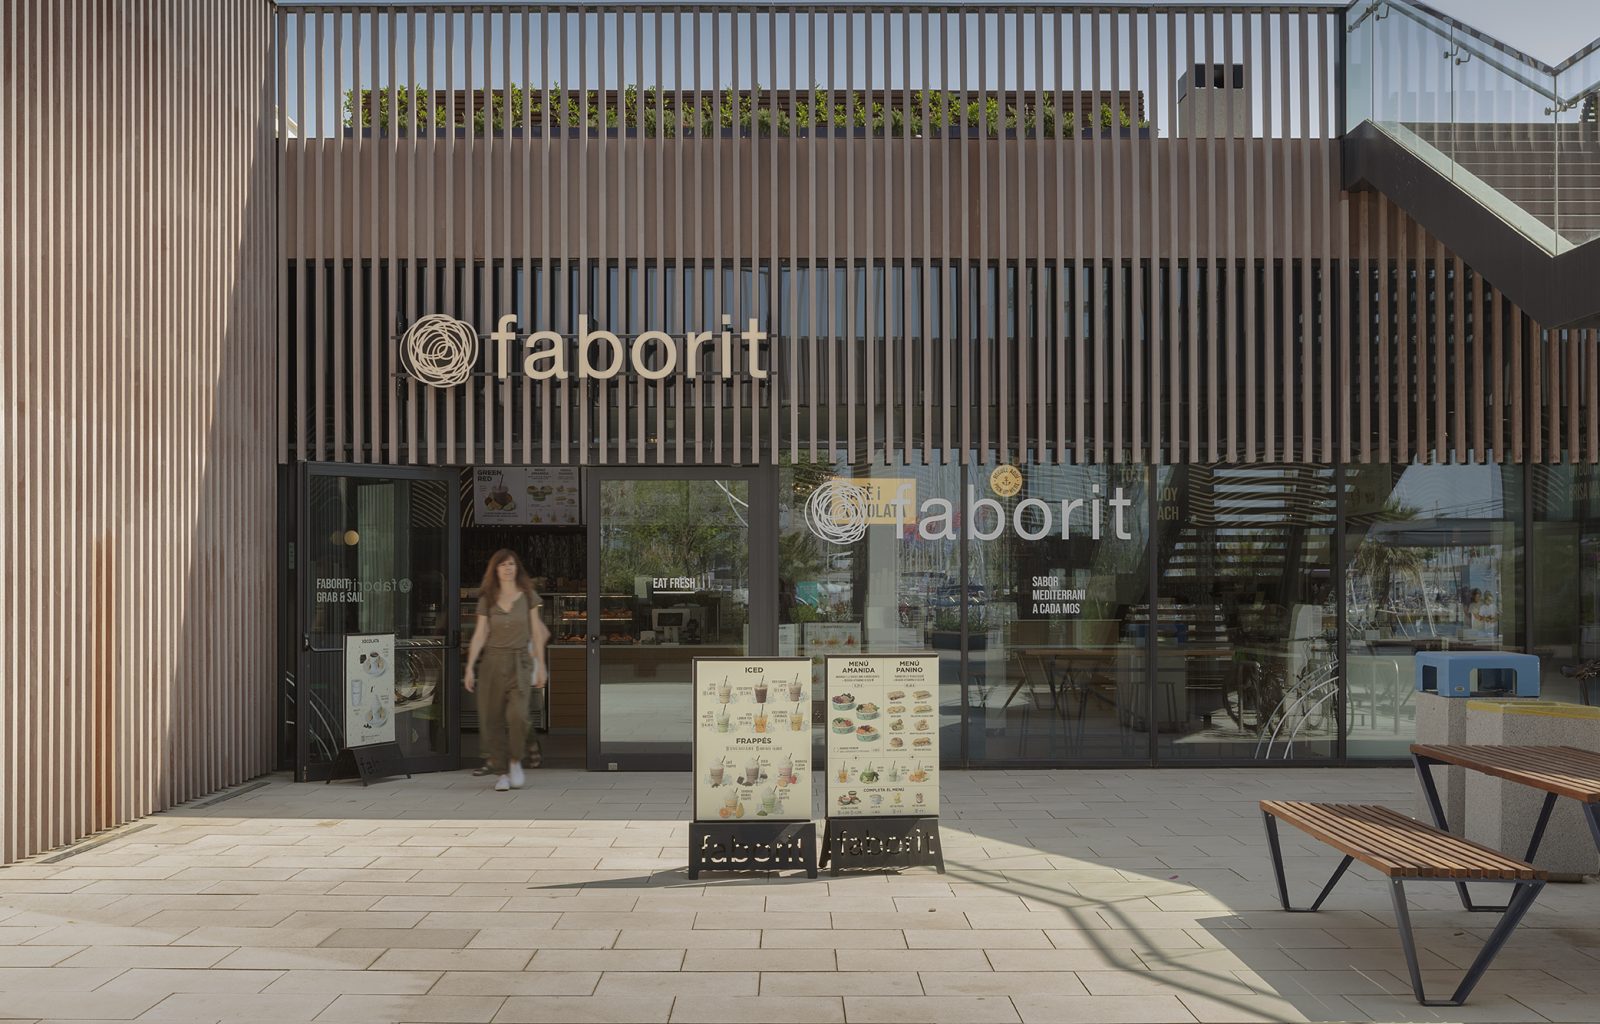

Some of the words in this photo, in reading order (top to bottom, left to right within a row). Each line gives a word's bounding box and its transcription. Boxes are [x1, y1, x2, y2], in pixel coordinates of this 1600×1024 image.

[491, 314, 767, 379] faborit
[891, 484, 1132, 540] faborit
[1157, 506, 1179, 520] ACH
[316, 578, 349, 589] FABORIT
[653, 578, 668, 589] EAT
[669, 577, 695, 589] FRESH
[1032, 576, 1059, 587] SABOR
[316, 592, 338, 603] GRAB
[339, 592, 345, 603] &
[347, 592, 364, 603] SAIL
[1032, 590, 1086, 600] MEDITERRANI
[1032, 603, 1038, 614] A
[1040, 603, 1060, 614] CADA
[1062, 603, 1080, 614] MOS
[701, 834, 804, 862] faborit
[838, 829, 935, 856] faborit
